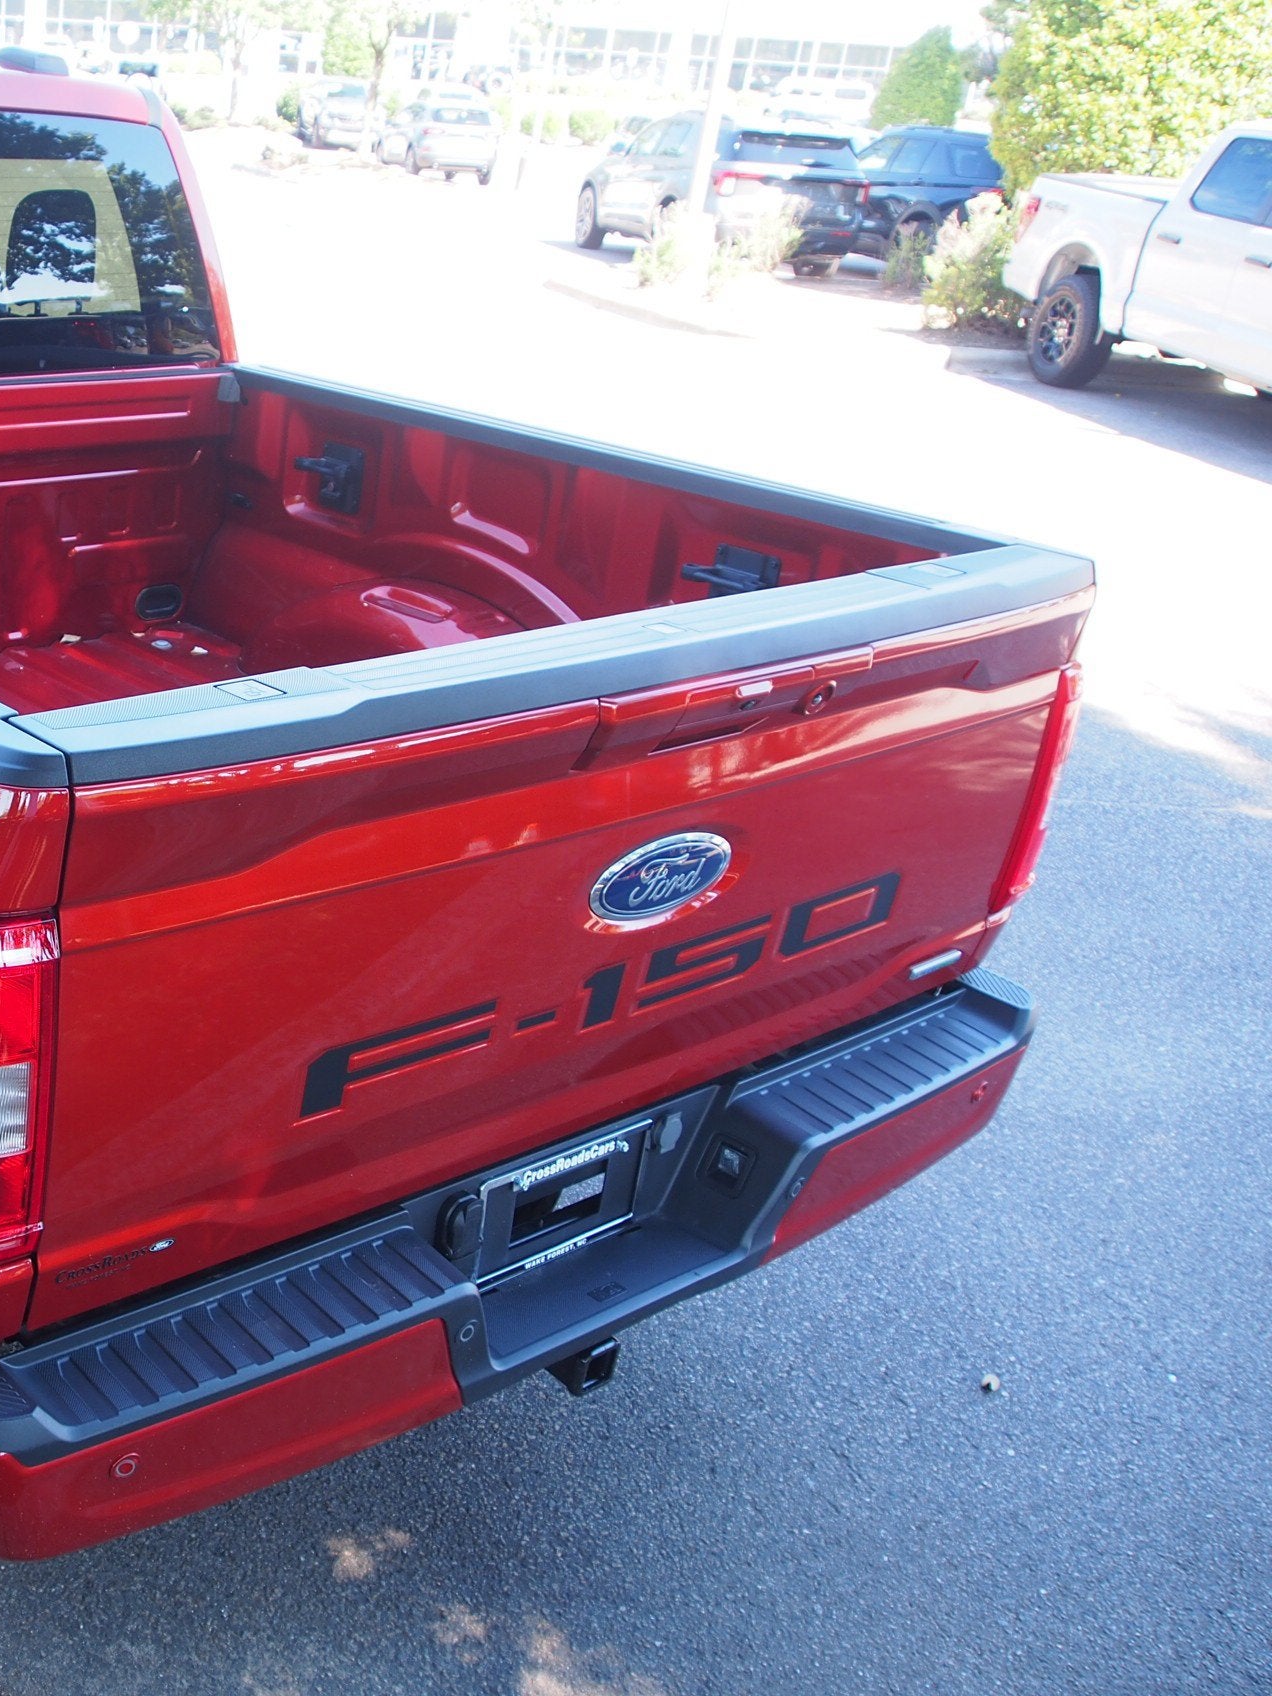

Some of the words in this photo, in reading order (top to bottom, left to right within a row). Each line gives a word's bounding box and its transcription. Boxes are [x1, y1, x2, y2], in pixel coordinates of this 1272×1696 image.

[628, 852, 706, 908] Ford
[298, 873, 903, 1119] F-150
[522, 1140, 616, 1183] CrossRoadsCars
[524, 1256, 546, 1270] WAKE
[576, 1238, 587, 1248] NC
